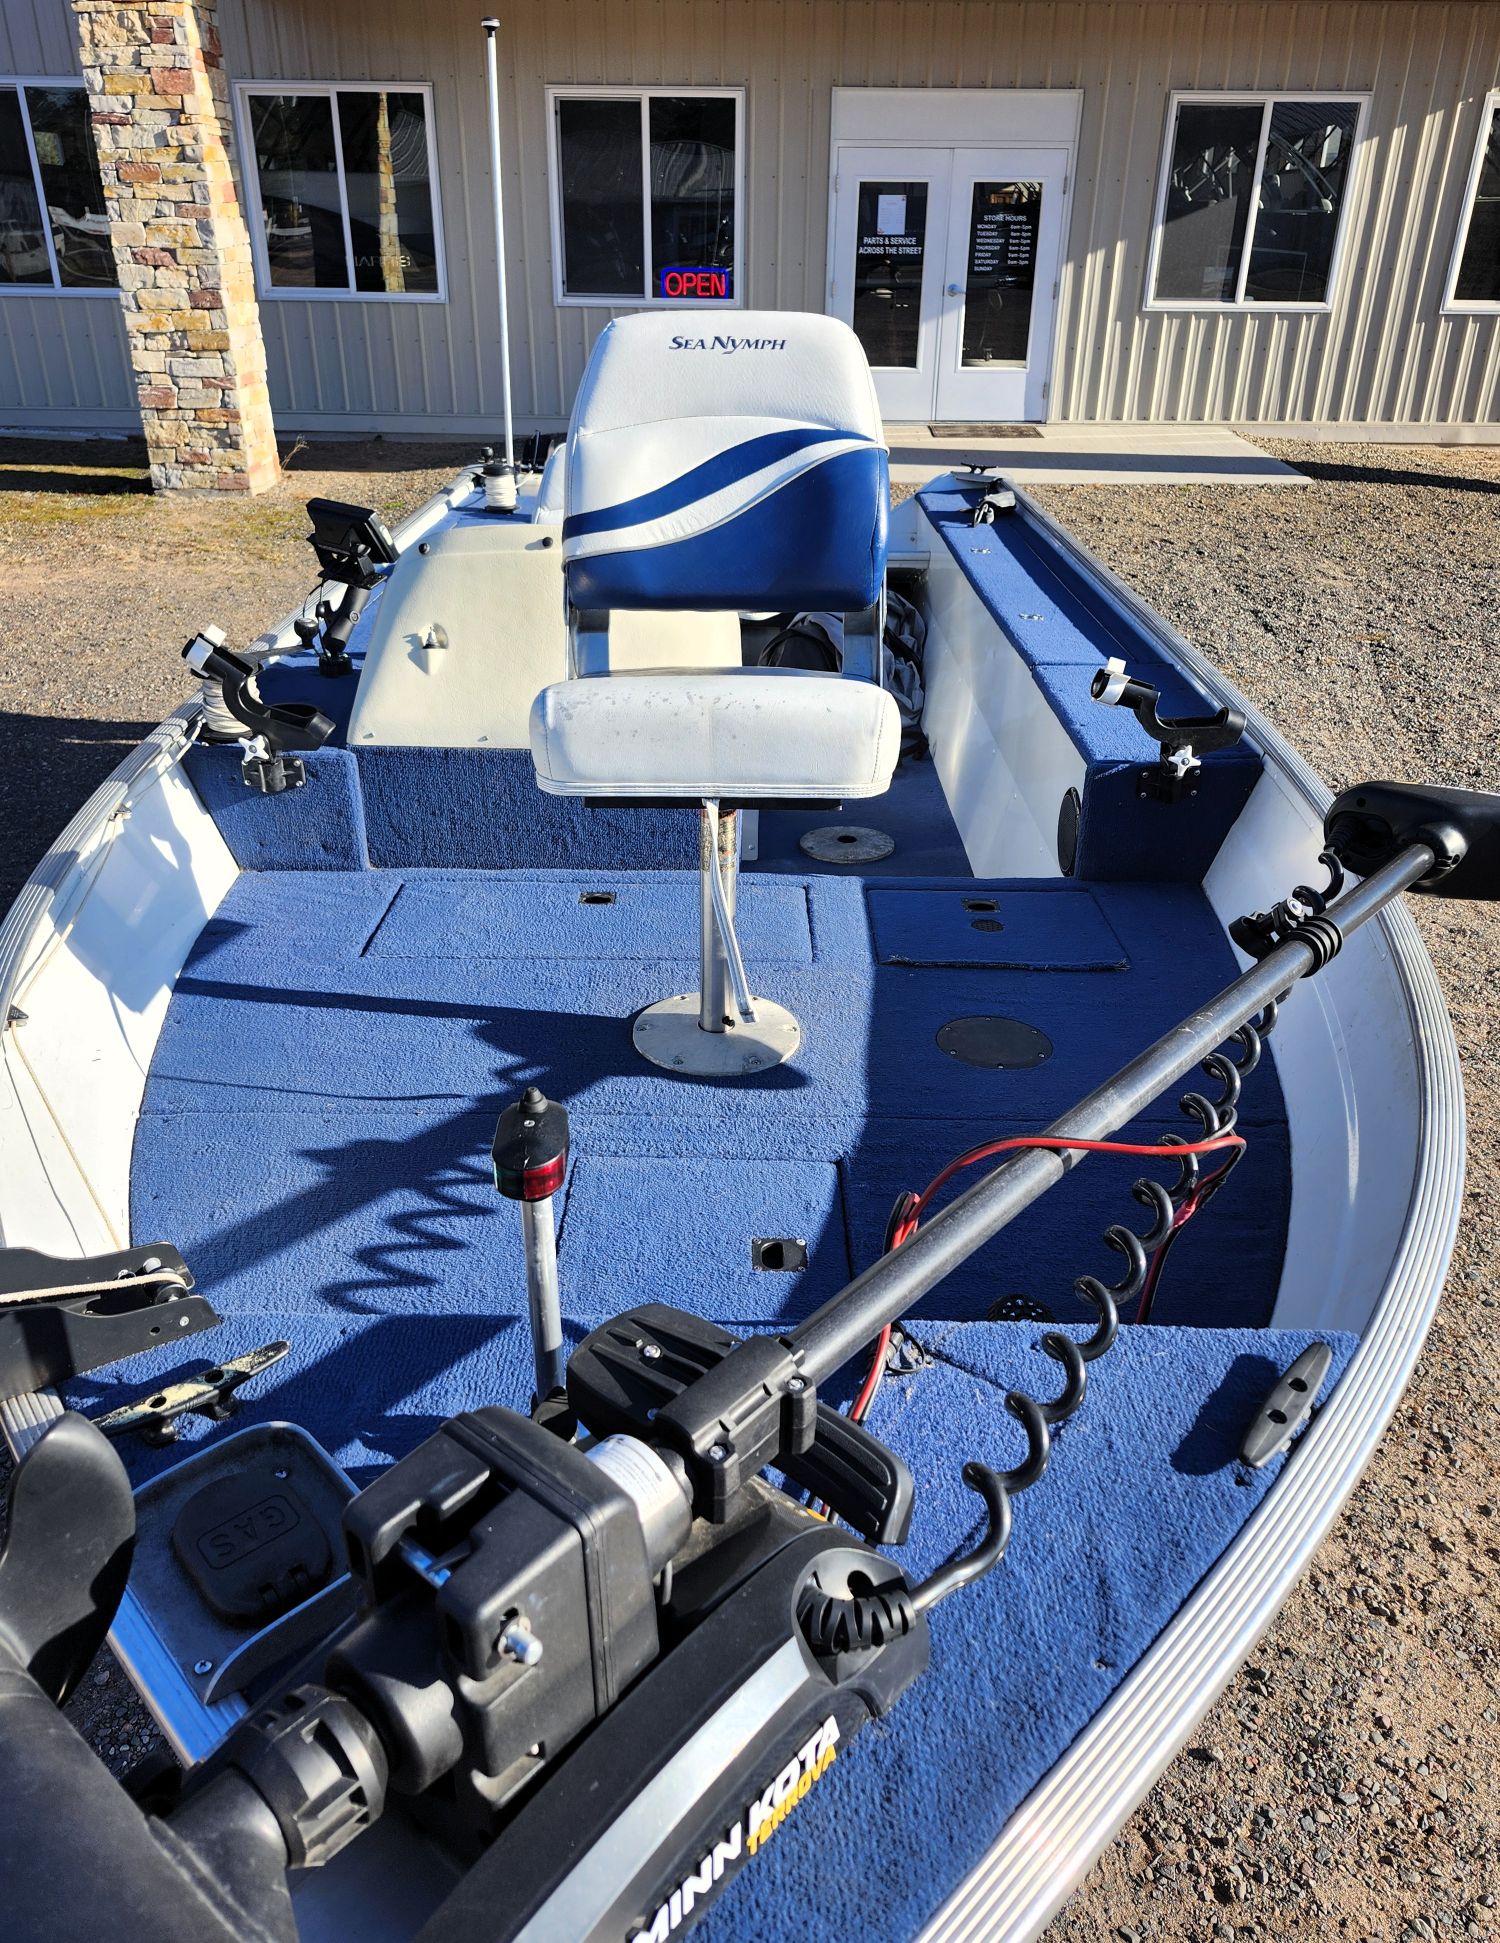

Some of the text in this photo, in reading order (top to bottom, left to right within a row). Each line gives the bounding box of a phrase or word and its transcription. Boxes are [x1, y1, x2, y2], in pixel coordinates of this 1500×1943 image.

[858, 246, 922, 254] ACROSS THE STREET
[863, 236, 916, 245] PARTS & SERVICE
[665, 272, 726, 297] OPEN
[668, 335, 706, 350] SEA
[748, 1714, 841, 1838] KOTA
[746, 1744, 837, 1856] TERROVA
